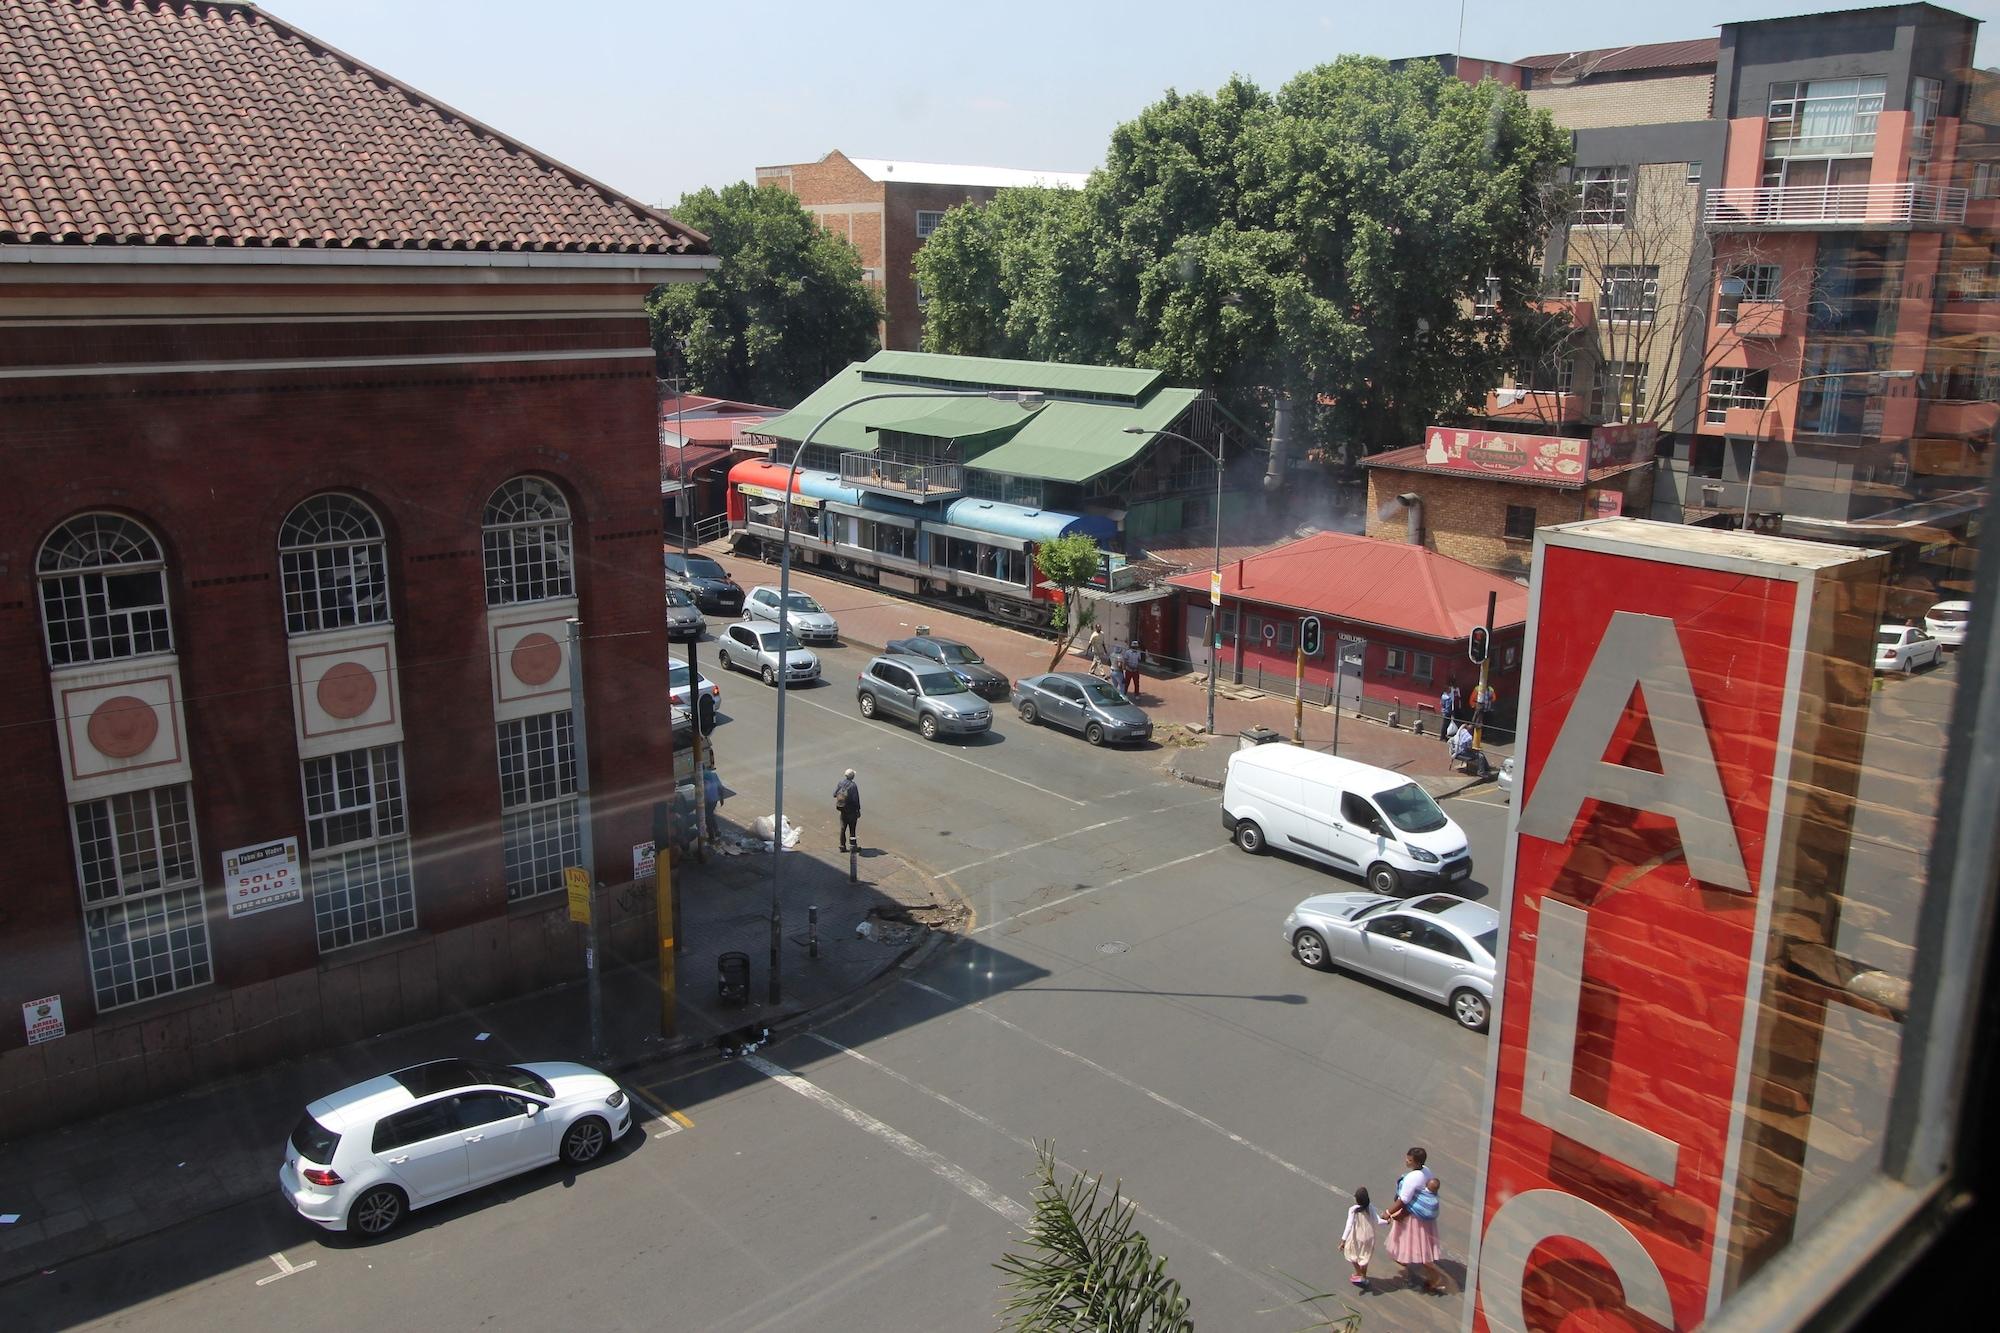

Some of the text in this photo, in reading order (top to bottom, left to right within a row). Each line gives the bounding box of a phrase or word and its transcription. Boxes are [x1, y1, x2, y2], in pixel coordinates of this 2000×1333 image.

[240, 869, 288, 886] SOLD
[239, 880, 283, 897] SOLD
[29, 1022, 62, 1034] RESPONSE
[33, 1018, 57, 1028] ARMED
